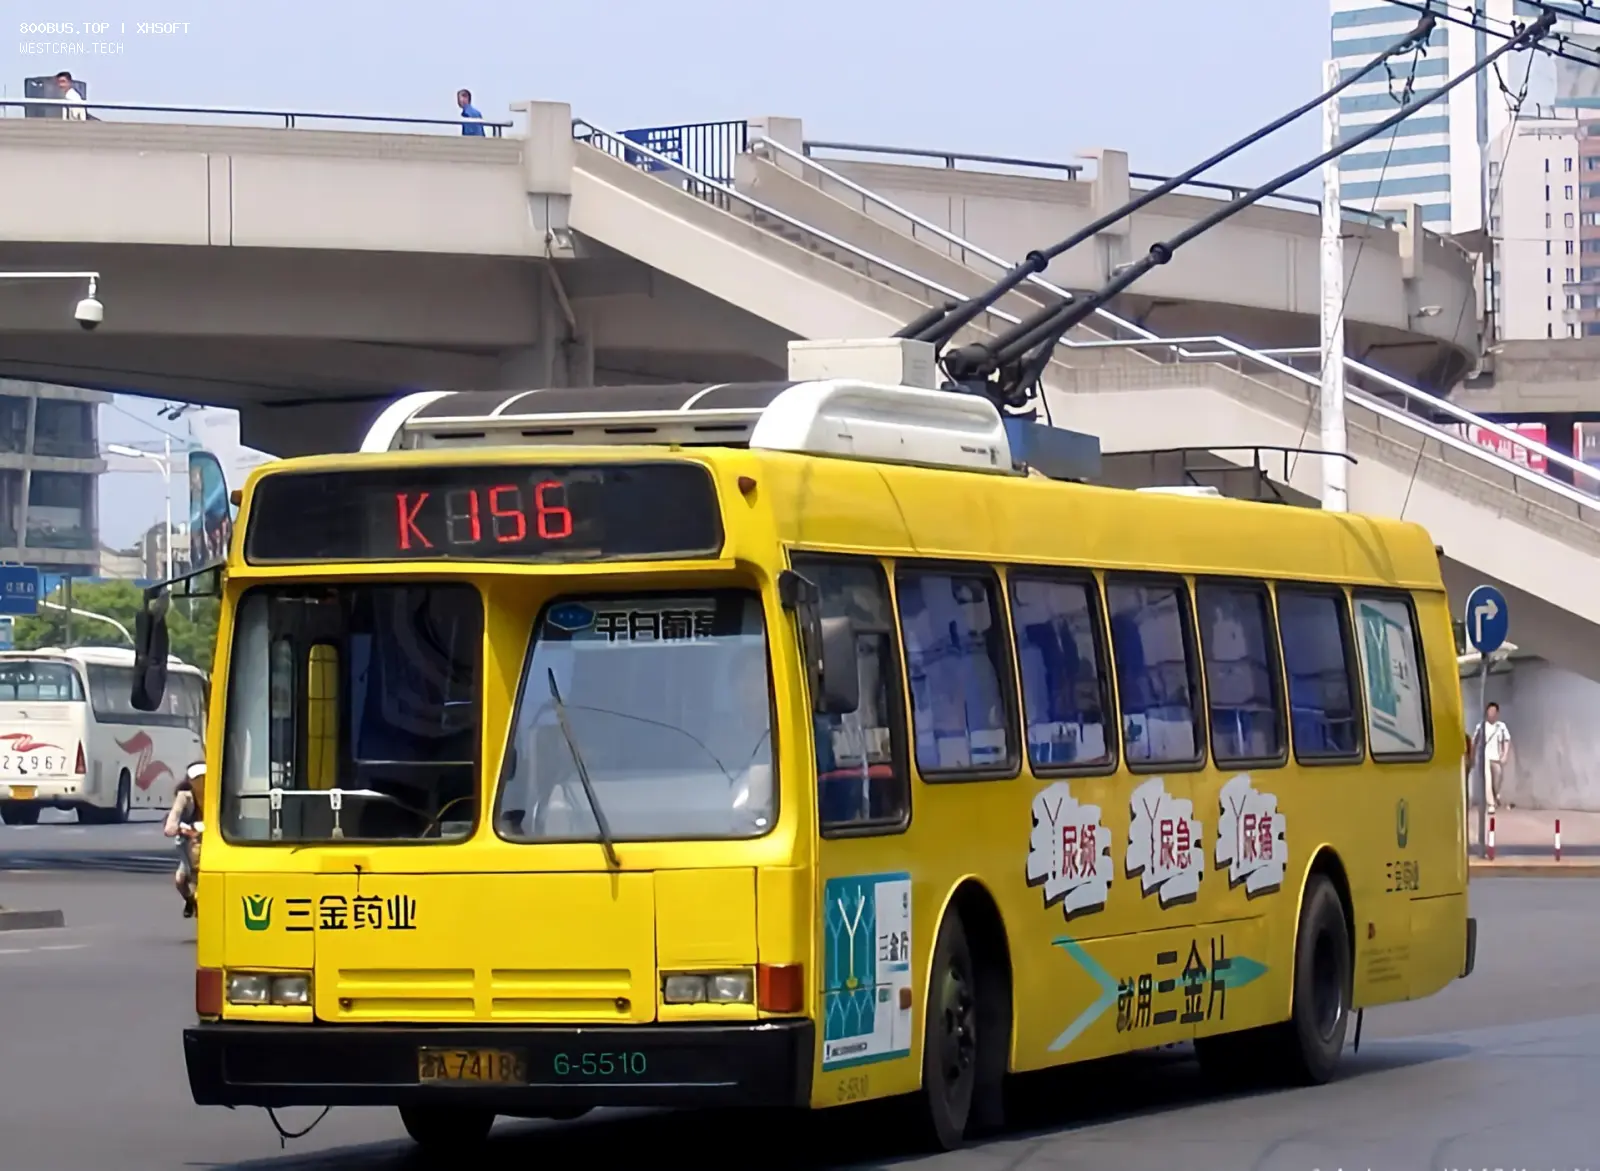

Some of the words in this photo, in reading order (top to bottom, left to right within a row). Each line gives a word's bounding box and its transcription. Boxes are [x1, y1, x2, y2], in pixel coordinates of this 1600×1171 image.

[1160, 816, 1192, 870] 尿急
[285, 895, 417, 931] 三金药业
[554, 1052, 647, 1075] 6-5510
